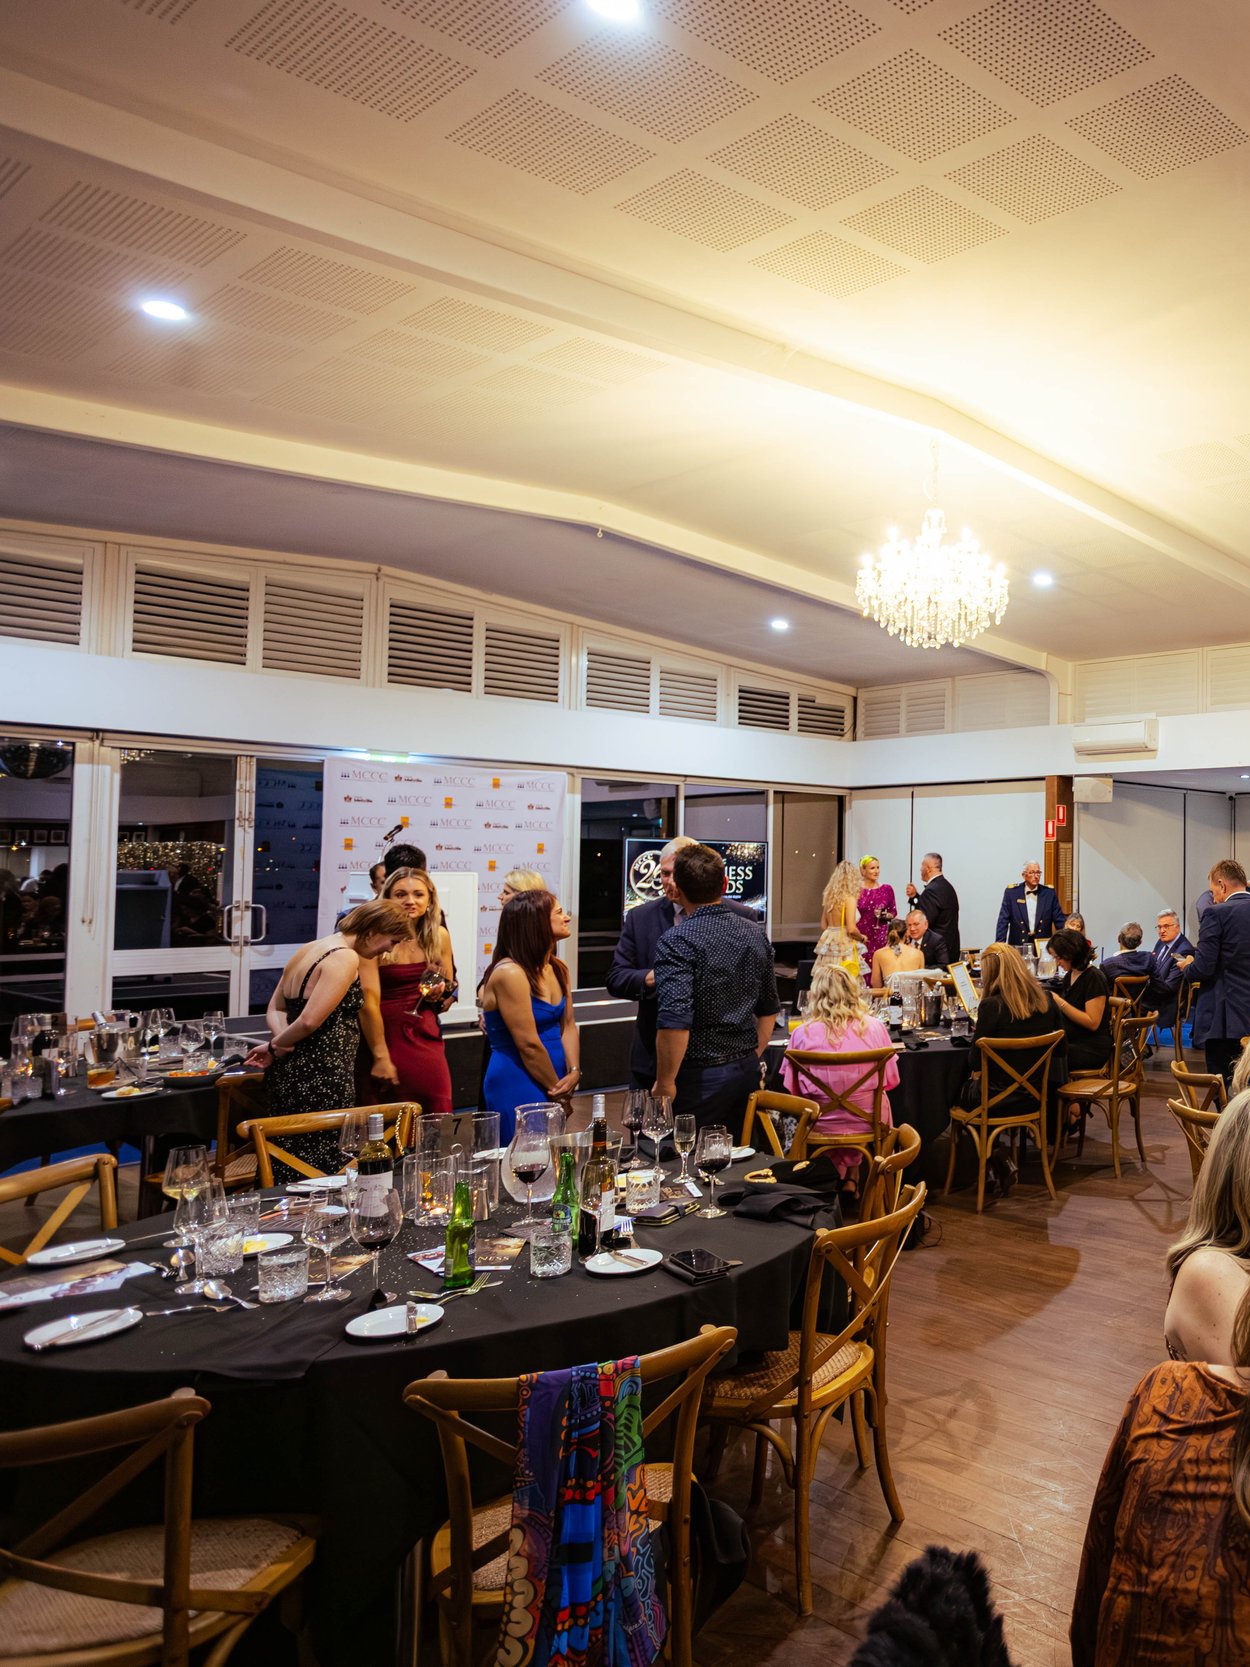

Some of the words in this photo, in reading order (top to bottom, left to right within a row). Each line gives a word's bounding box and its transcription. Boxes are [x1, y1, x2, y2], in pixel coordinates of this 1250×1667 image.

[352, 770, 388, 781] MCCC
[444, 776, 476, 786] MCCC
[526, 781, 556, 791] MCCC
[398, 794, 432, 805] MCCC
[485, 799, 516, 808] MCCC
[351, 815, 387, 826] MCCC
[440, 818, 472, 828] MCCC
[523, 820, 553, 830] MCCC
[482, 842, 514, 853] MCCC
[439, 860, 472, 870] MCCC
[521, 861, 550, 870] MCCC
[452, 1118, 462, 1135] 7
